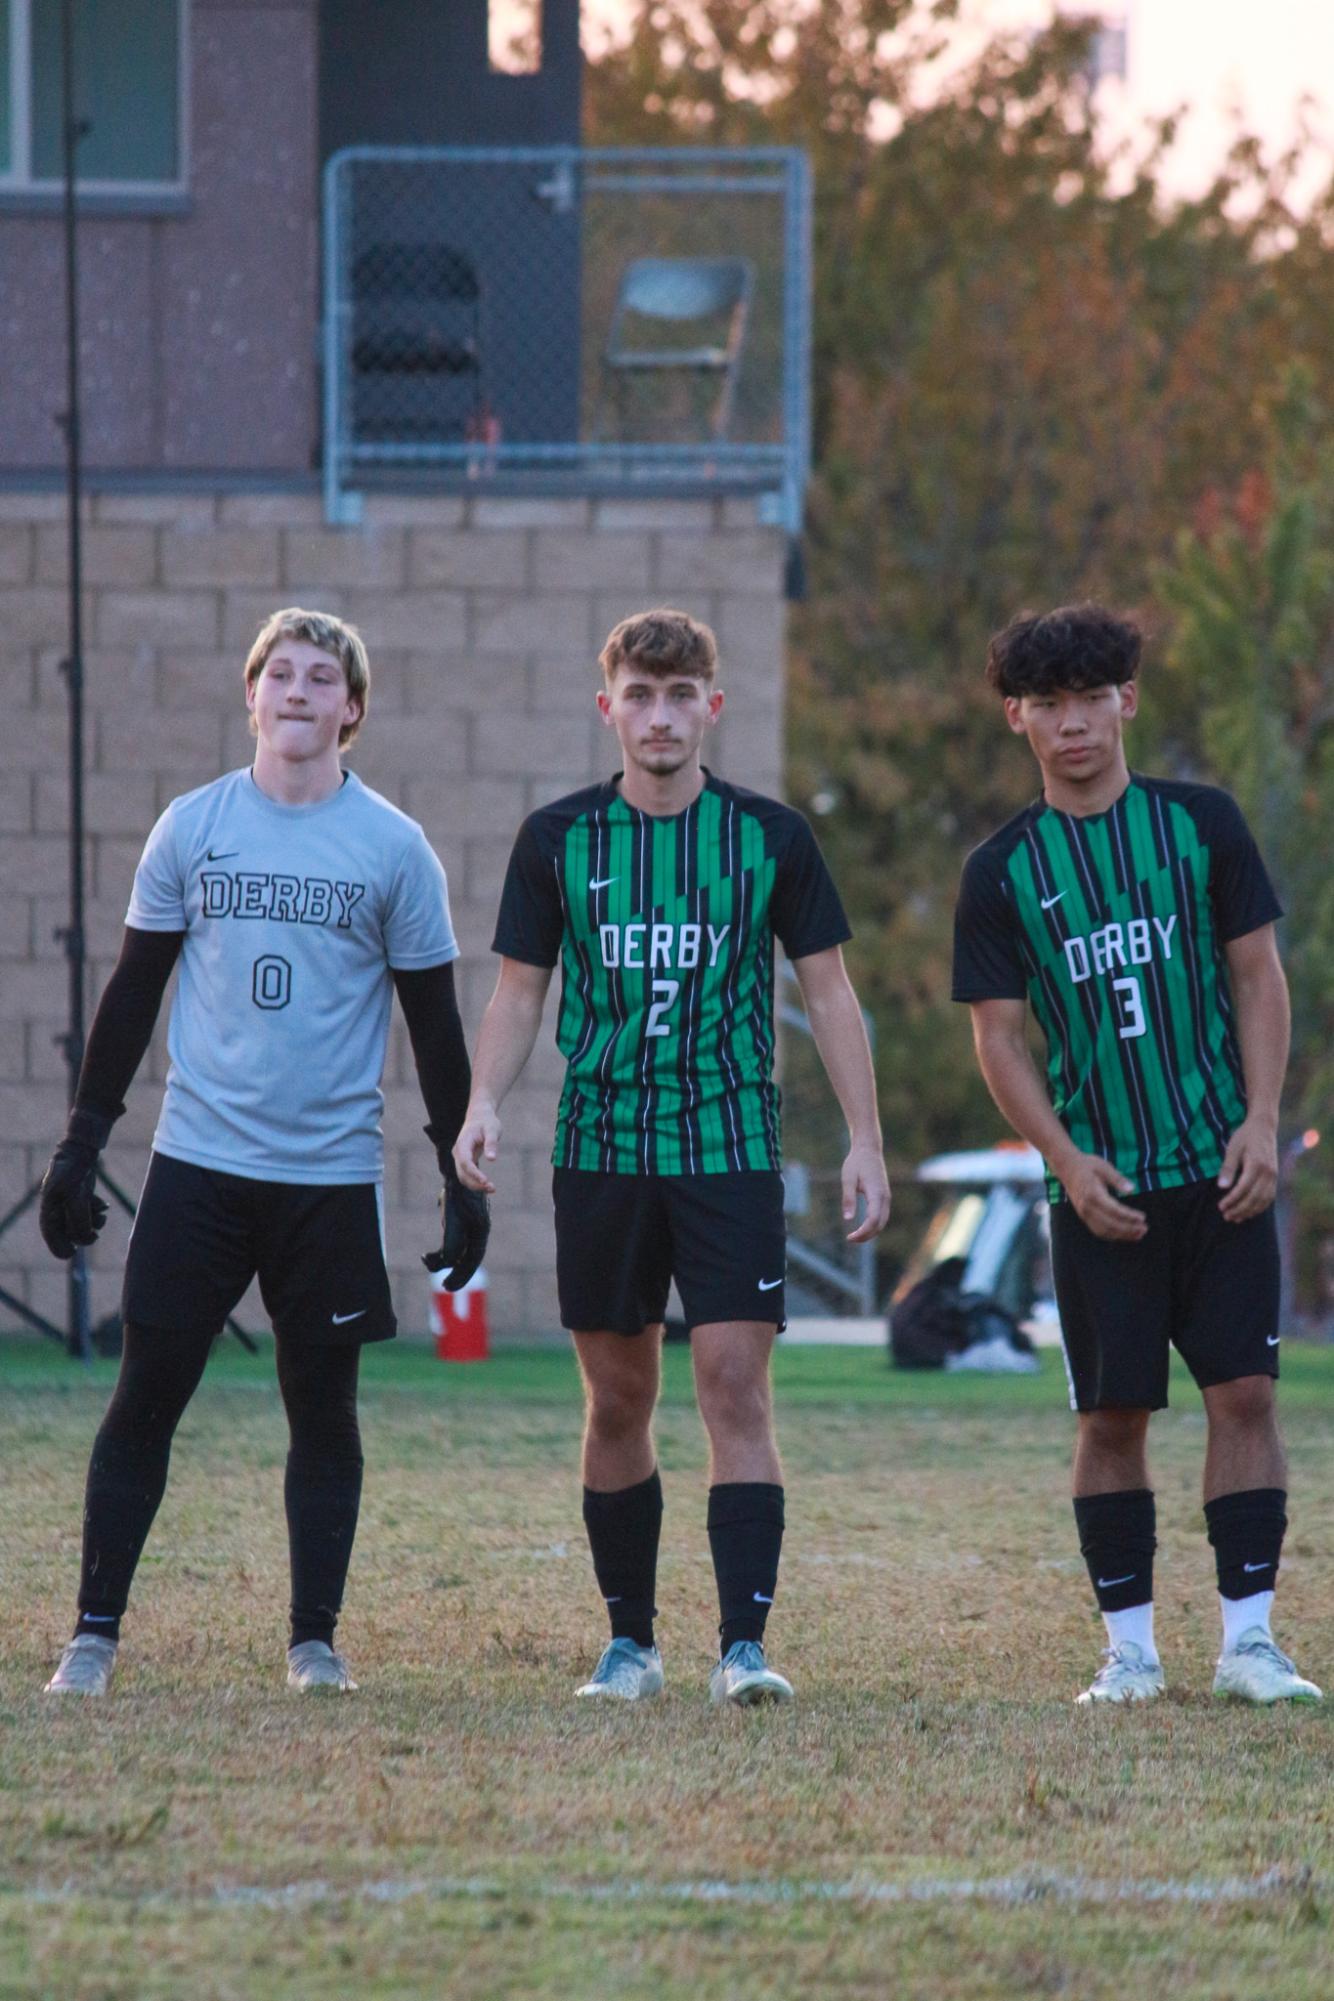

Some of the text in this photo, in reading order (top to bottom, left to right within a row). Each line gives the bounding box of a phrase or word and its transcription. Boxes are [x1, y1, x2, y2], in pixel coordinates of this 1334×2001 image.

[200, 872, 365, 928] DERBY
[599, 923, 730, 969] DERBY
[645, 979, 680, 1038] 2
[1112, 976, 1147, 1040] 3
